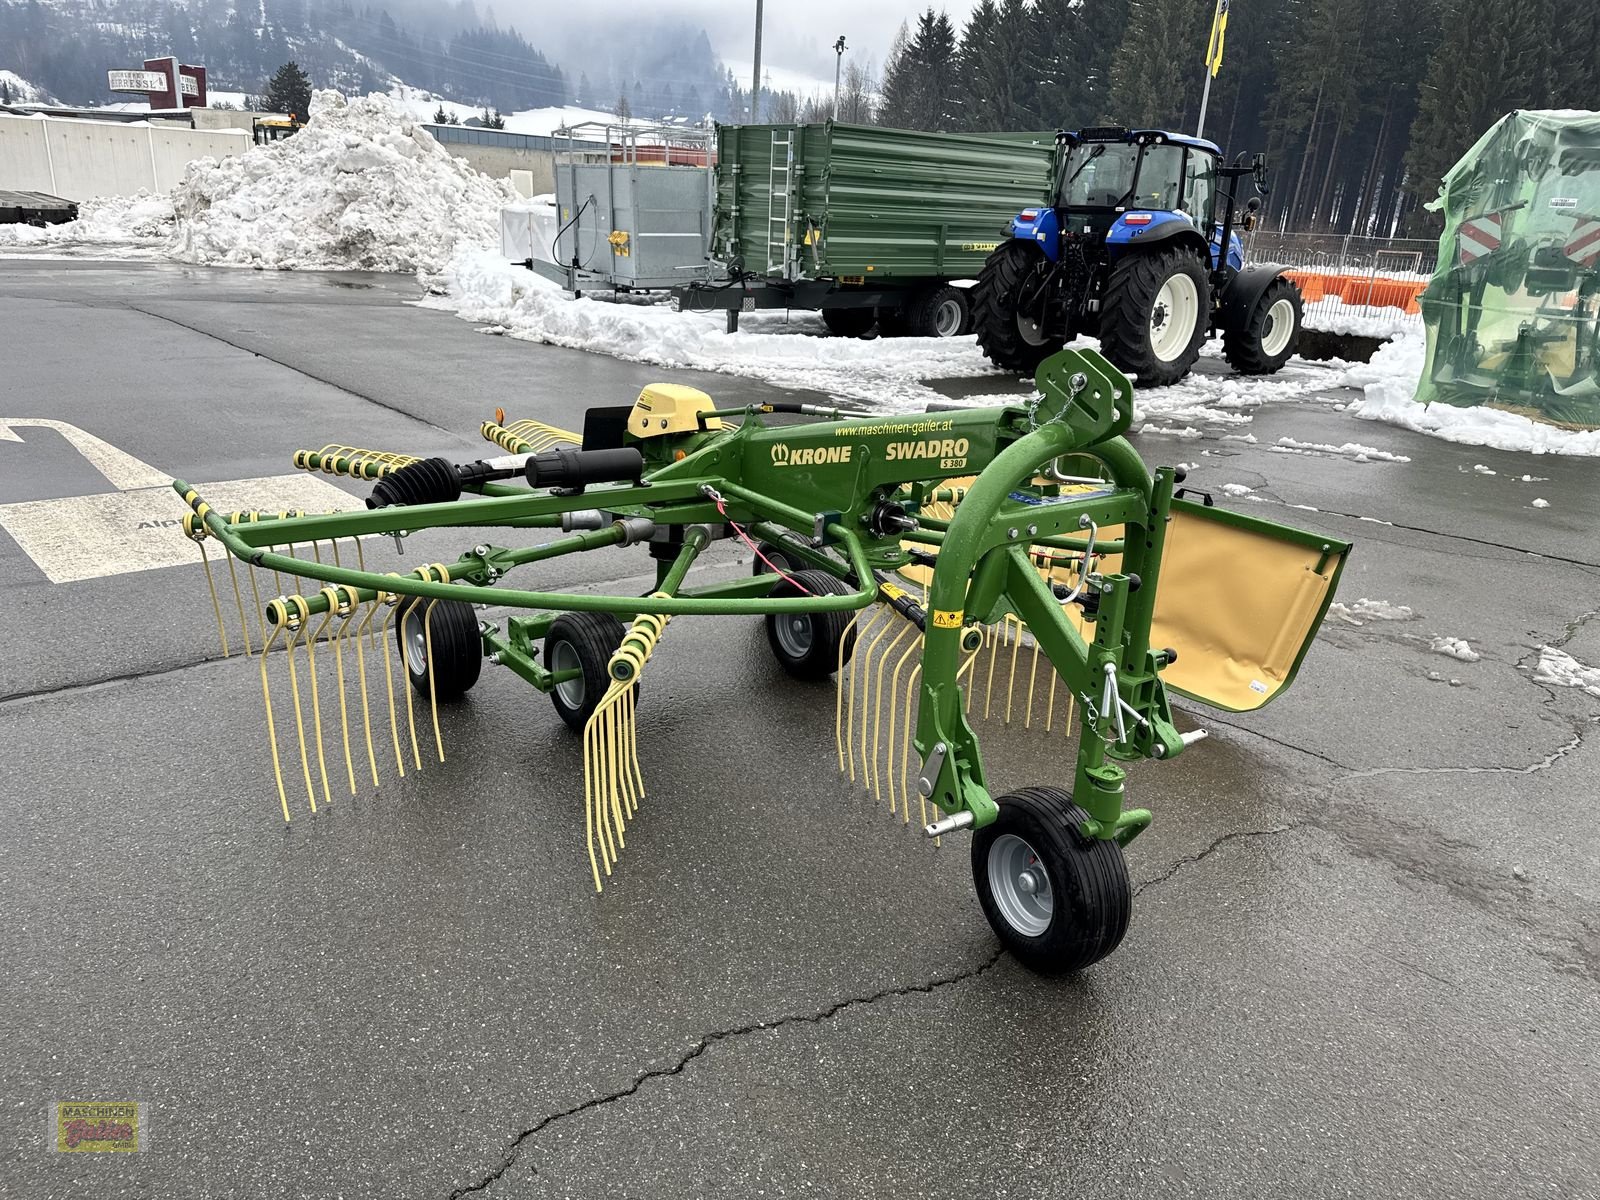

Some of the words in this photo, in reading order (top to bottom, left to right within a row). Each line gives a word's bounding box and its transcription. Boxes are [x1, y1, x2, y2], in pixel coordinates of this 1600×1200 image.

[835, 420, 953, 437] www.maschinen-gailer.at
[790, 446, 852, 465] KRONE
[886, 438, 969, 461] SWADRO
[943, 460, 949, 468] S
[950, 459, 963, 468] 380
